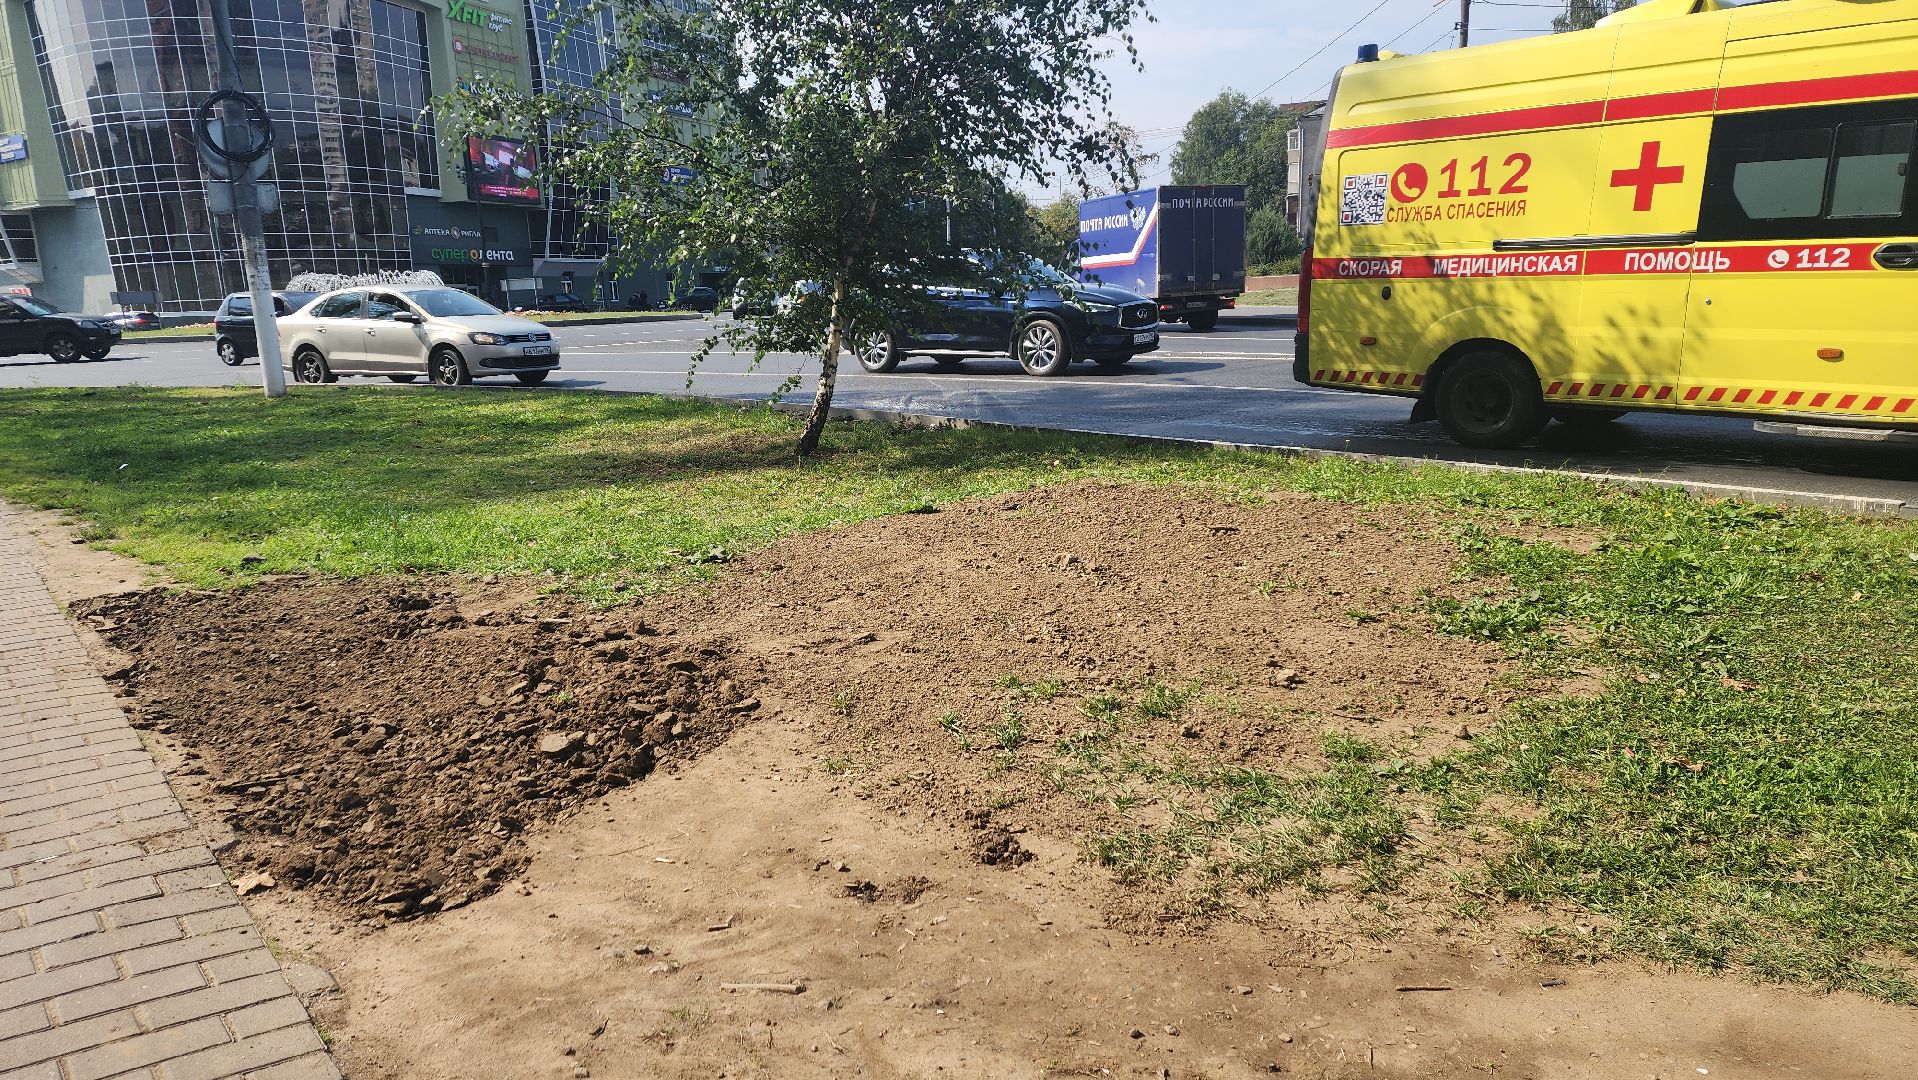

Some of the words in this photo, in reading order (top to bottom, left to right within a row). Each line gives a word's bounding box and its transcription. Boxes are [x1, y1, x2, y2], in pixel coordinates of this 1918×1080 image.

[1437, 152, 1532, 199] 112
[1203, 197, 1234, 208] РОССИИ
[1386, 205, 1442, 222] СЛУЖБА
[1446, 199, 1527, 219] СПАСЕНИЯ
[424, 227, 451, 236] АПТЕКА
[1080, 218, 1103, 233] ПОЧТА
[1104, 214, 1129, 228] РОССИИ
[431, 247, 469, 262] супер
[1338, 259, 1402, 276] СКОРАЯ
[1433, 254, 1578, 277] МЕДИЦИНСКАЯ
[1624, 251, 1731, 272] ПОМОЩЬ
[1796, 247, 1851, 269] 112
